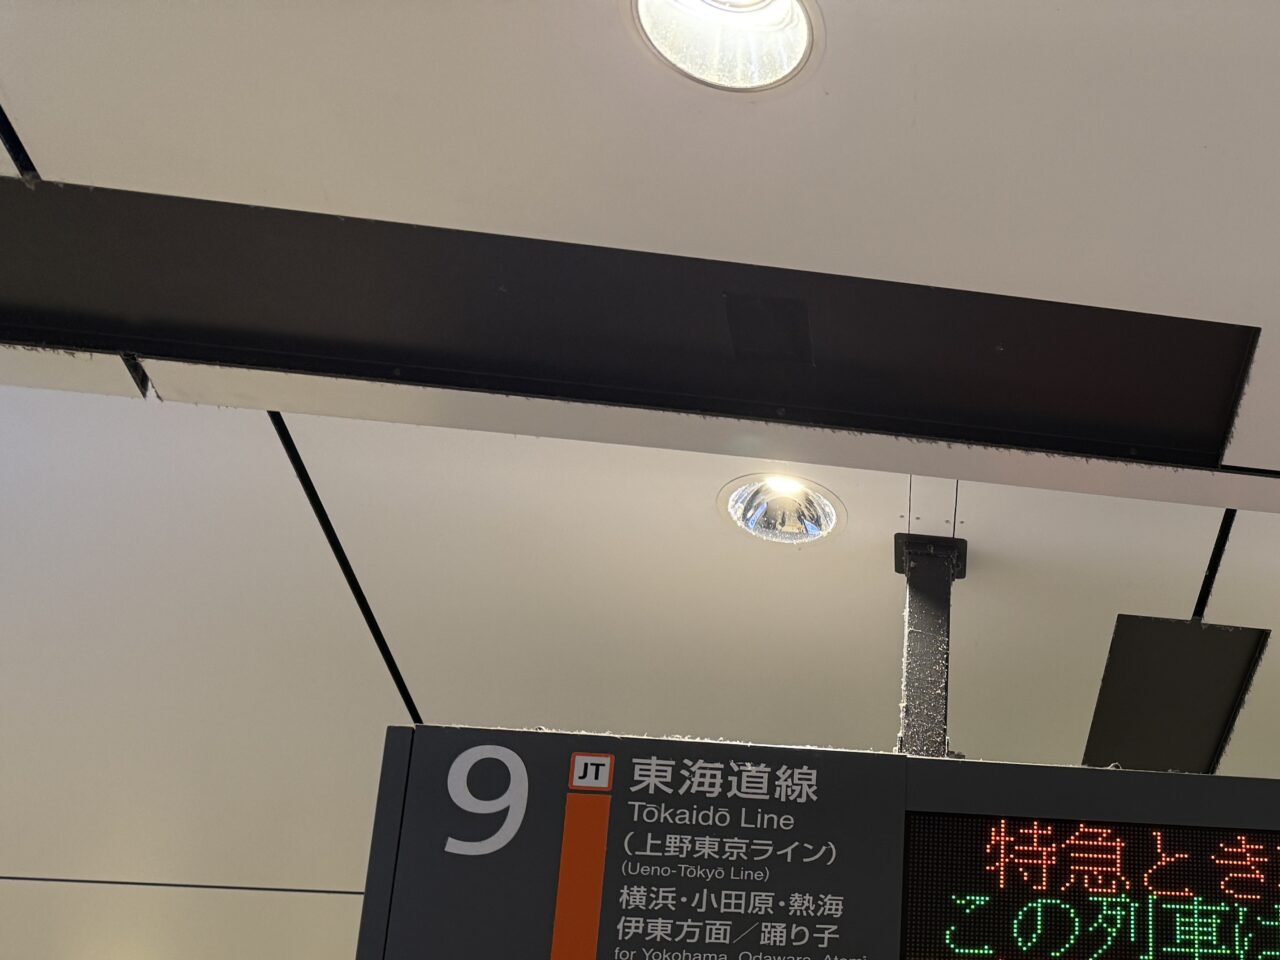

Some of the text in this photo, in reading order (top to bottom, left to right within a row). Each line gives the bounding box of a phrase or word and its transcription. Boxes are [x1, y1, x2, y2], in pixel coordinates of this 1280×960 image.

[578, 762, 605, 782] JT
[629, 756, 819, 803] 東海道線
[444, 745, 529, 856] 9
[628, 801, 795, 830] Tōkaidō Line
[731, 865, 770, 882] Line)
[619, 886, 844, 918] 横浜・小田原・熱海
[614, 947, 636, 960] for
